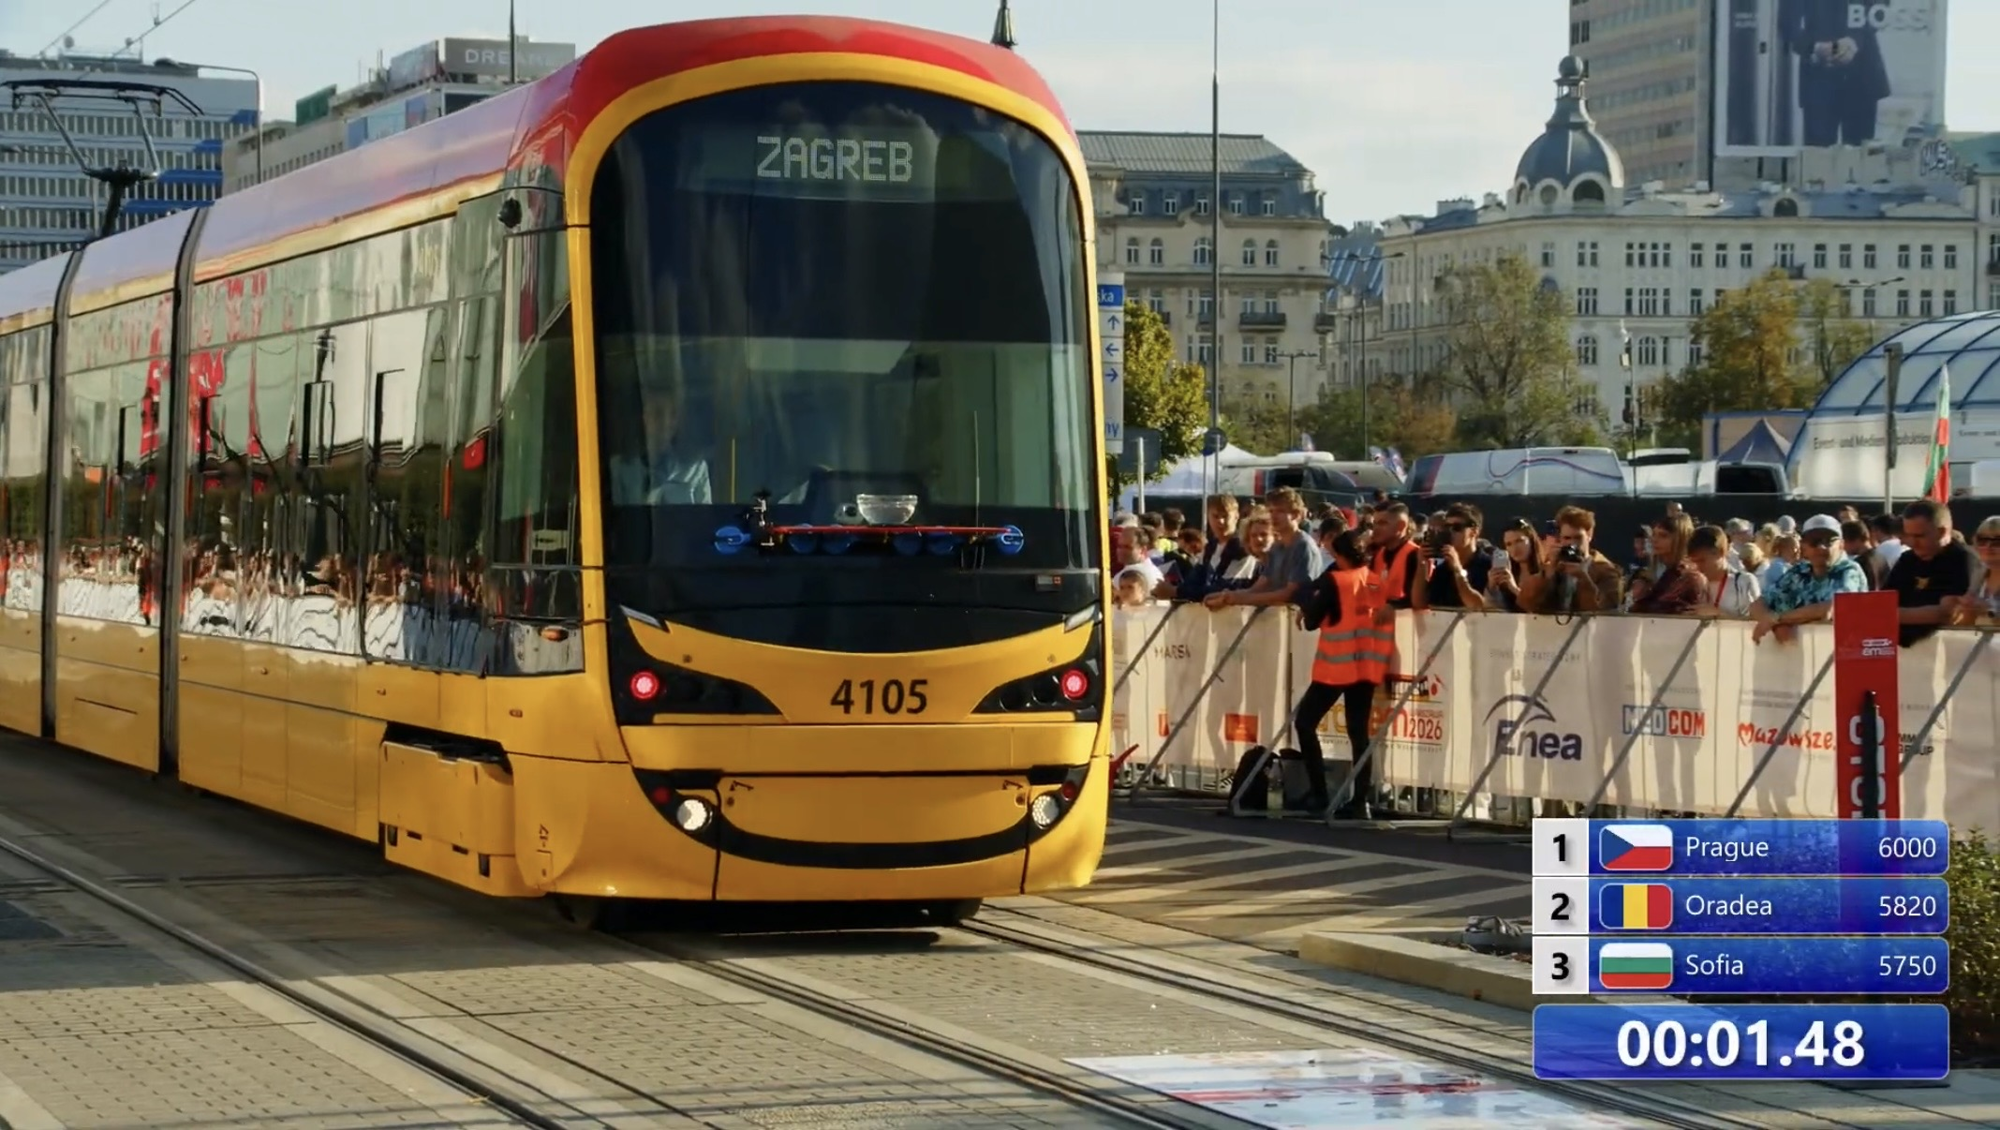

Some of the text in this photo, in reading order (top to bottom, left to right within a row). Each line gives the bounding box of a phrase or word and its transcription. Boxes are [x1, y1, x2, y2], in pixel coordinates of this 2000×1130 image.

[757, 136, 913, 182] ZAGREB
[830, 679, 928, 715] 4105
[1409, 718, 1443, 740] 2026
[1496, 719, 1582, 761] Enea
[1738, 723, 1836, 750] Mazwsze.
